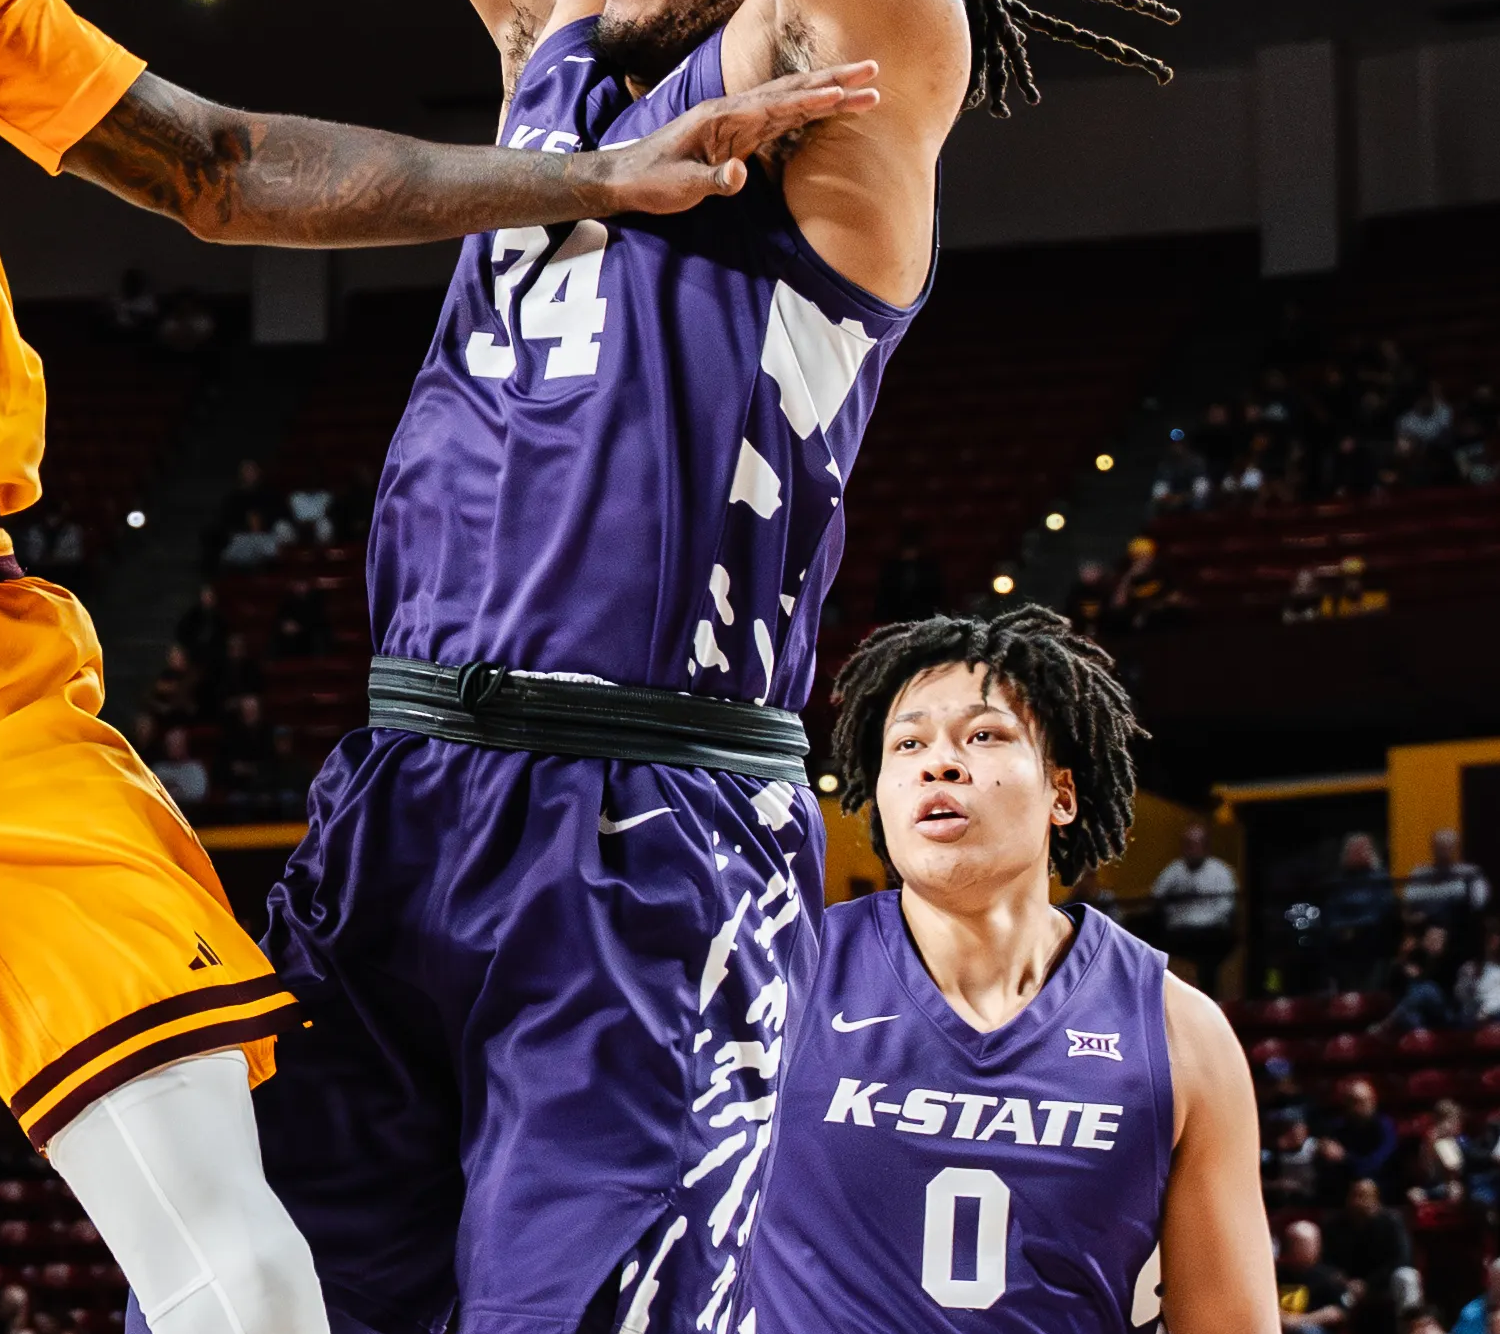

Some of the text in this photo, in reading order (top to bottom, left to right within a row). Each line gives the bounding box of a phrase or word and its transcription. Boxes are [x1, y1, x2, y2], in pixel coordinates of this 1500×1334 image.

[464, 220, 609, 381] 34
[823, 1077, 1124, 1151] K-STATE
[920, 1166, 1011, 1310] 0
